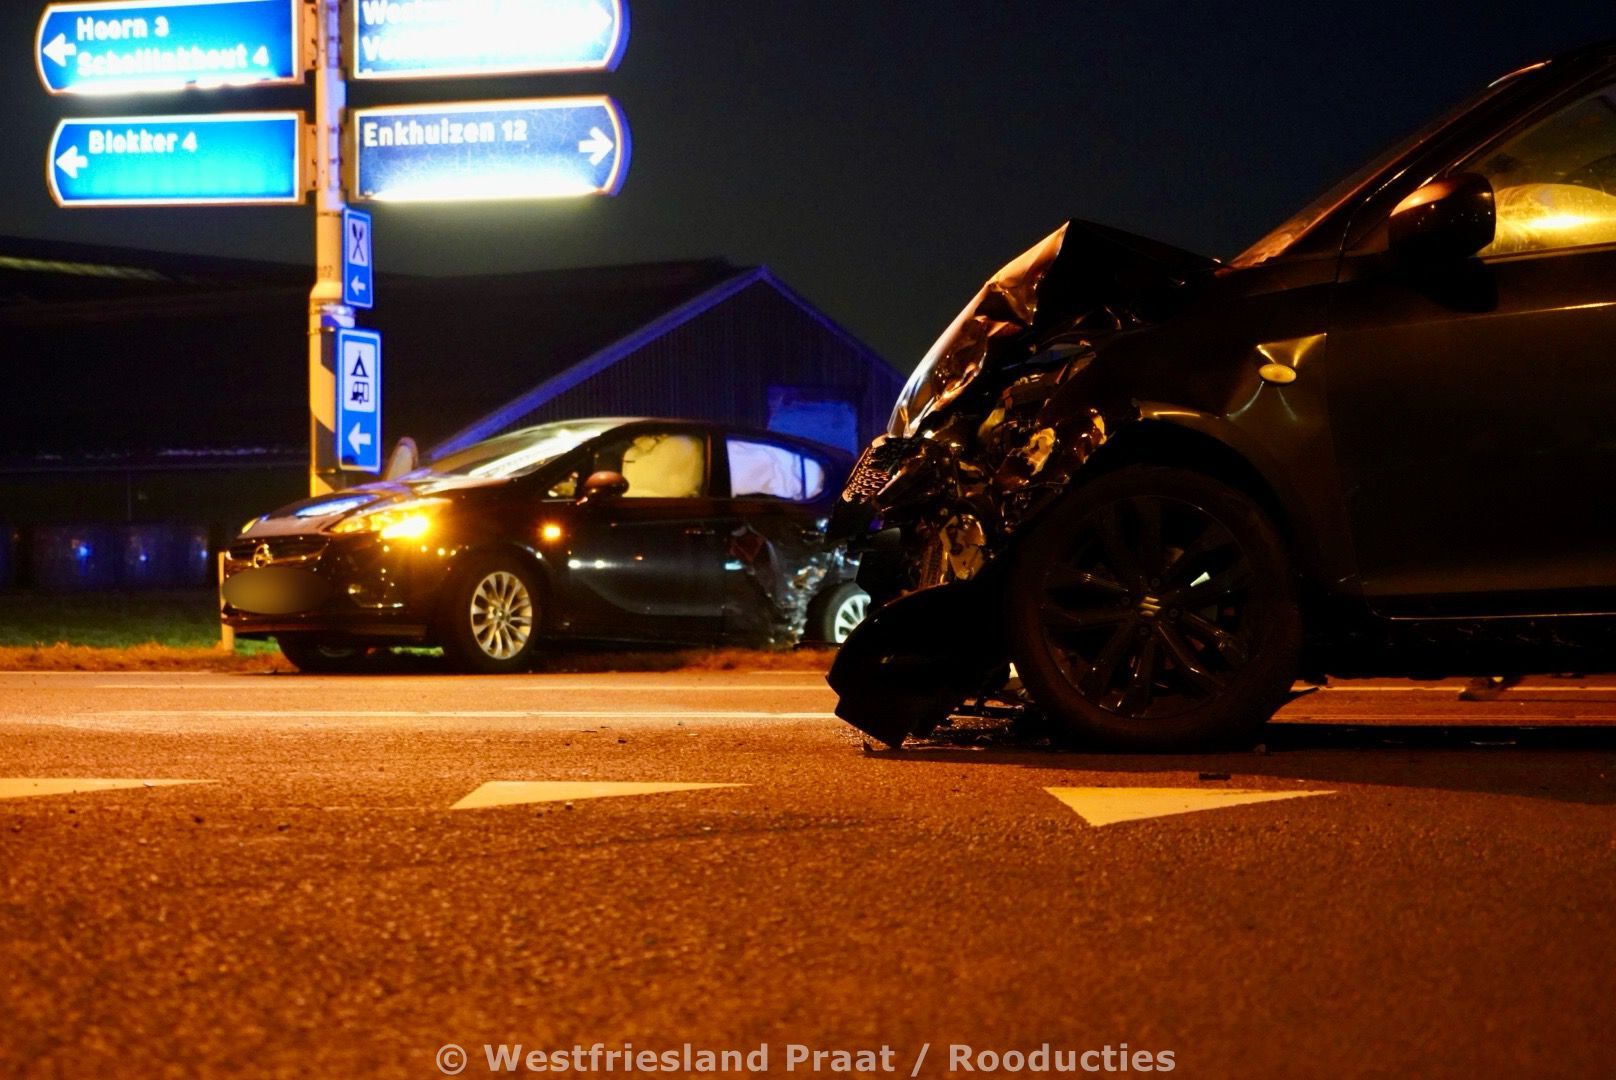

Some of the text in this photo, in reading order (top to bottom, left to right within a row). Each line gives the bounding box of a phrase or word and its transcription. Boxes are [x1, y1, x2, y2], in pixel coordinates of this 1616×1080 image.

[76, 15, 170, 41] Hoorn 3
[252, 45, 270, 67] 4
[88, 128, 198, 154] Blokker 4
[363, 117, 528, 147] Enkhuizen 12
